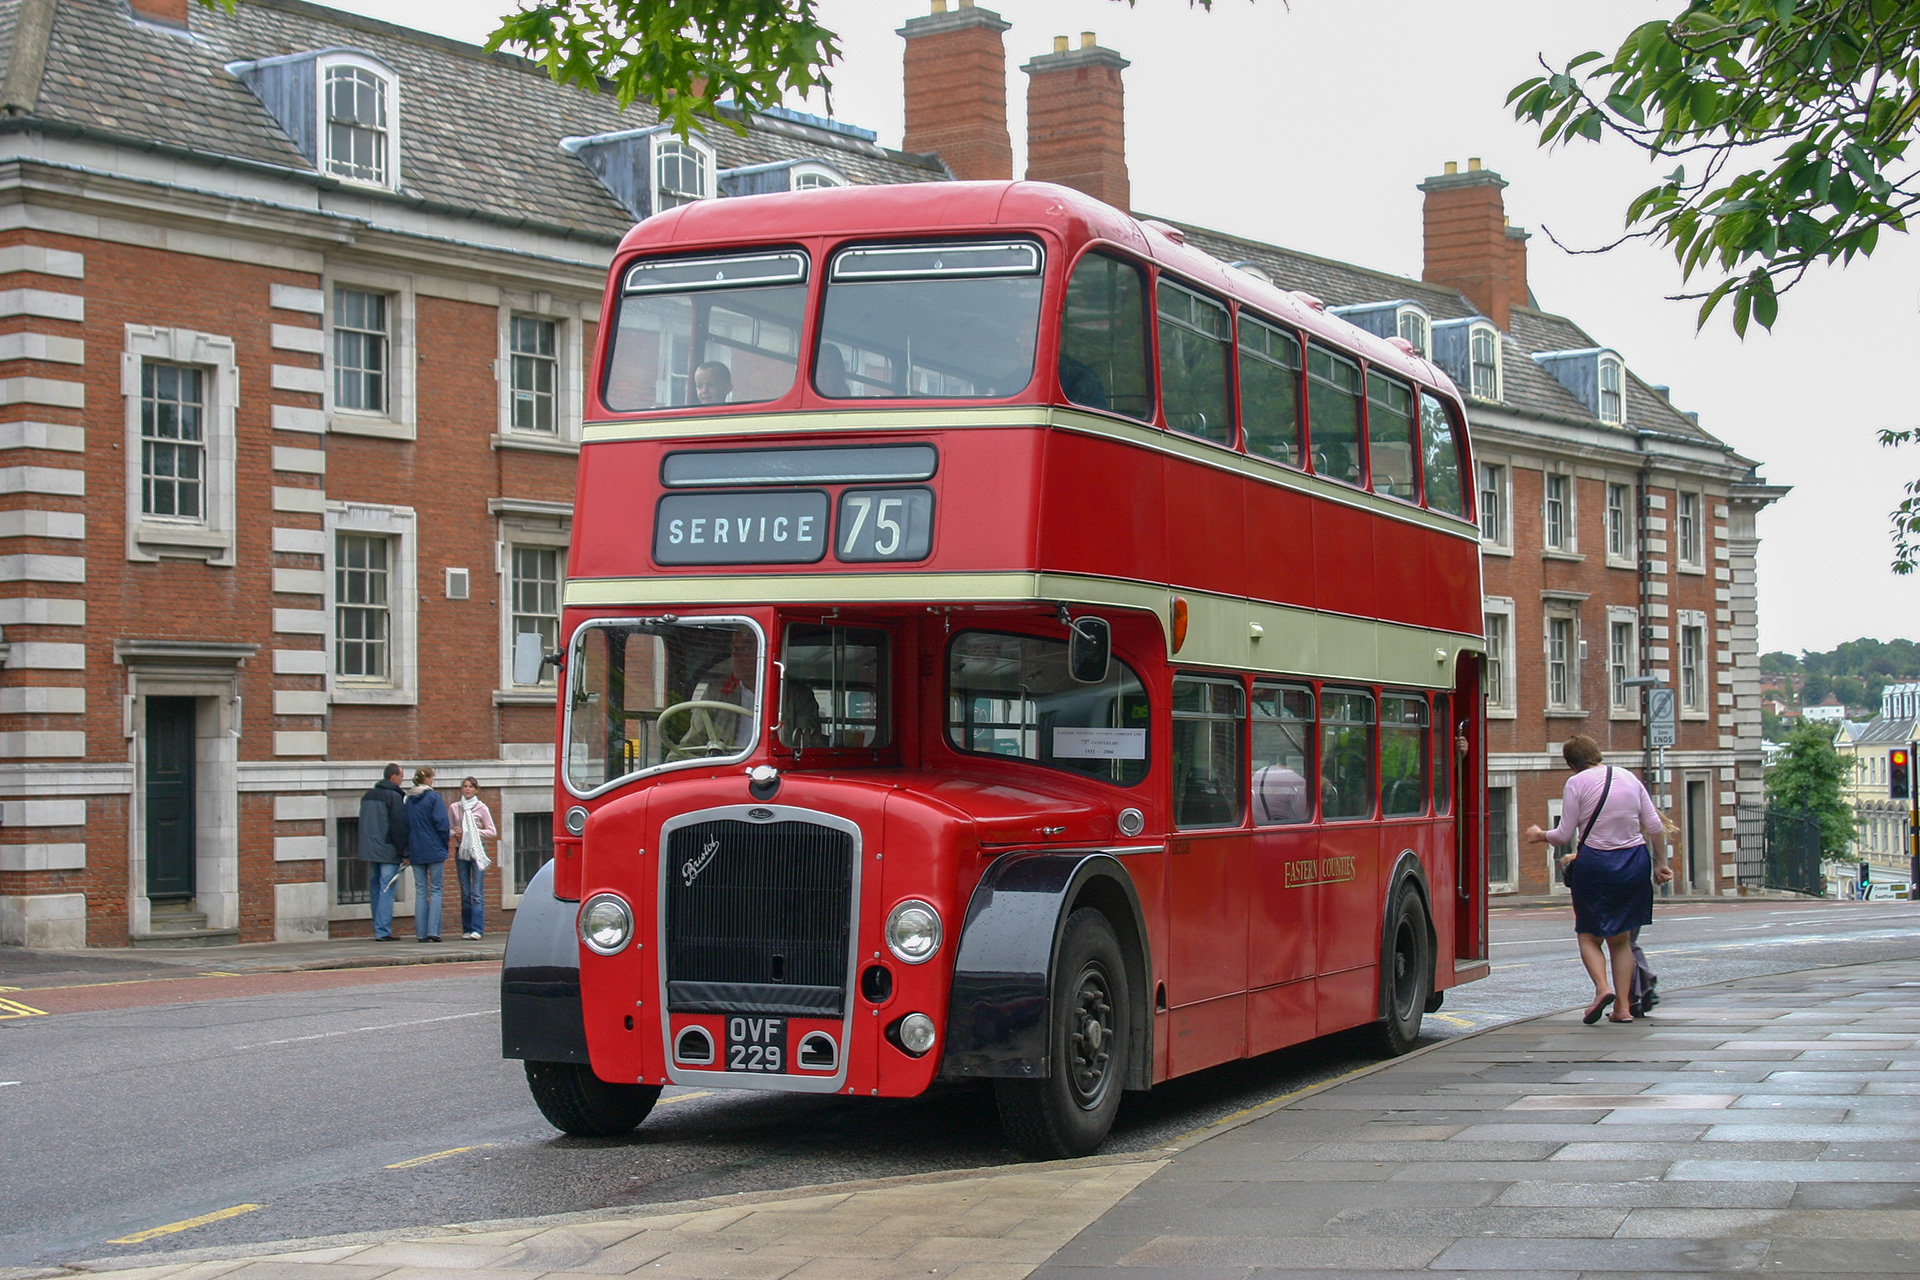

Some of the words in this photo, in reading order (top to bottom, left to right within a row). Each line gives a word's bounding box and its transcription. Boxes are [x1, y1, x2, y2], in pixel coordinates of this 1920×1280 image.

[669, 516, 814, 544] SERVICE
[842, 497, 903, 555] 75
[681, 833, 720, 887] Bristol
[1284, 859, 1318, 888] EASTERN
[1322, 856, 1356, 881] COUNTIES
[730, 1017, 781, 1043] OVF
[730, 1045, 781, 1071] 229
